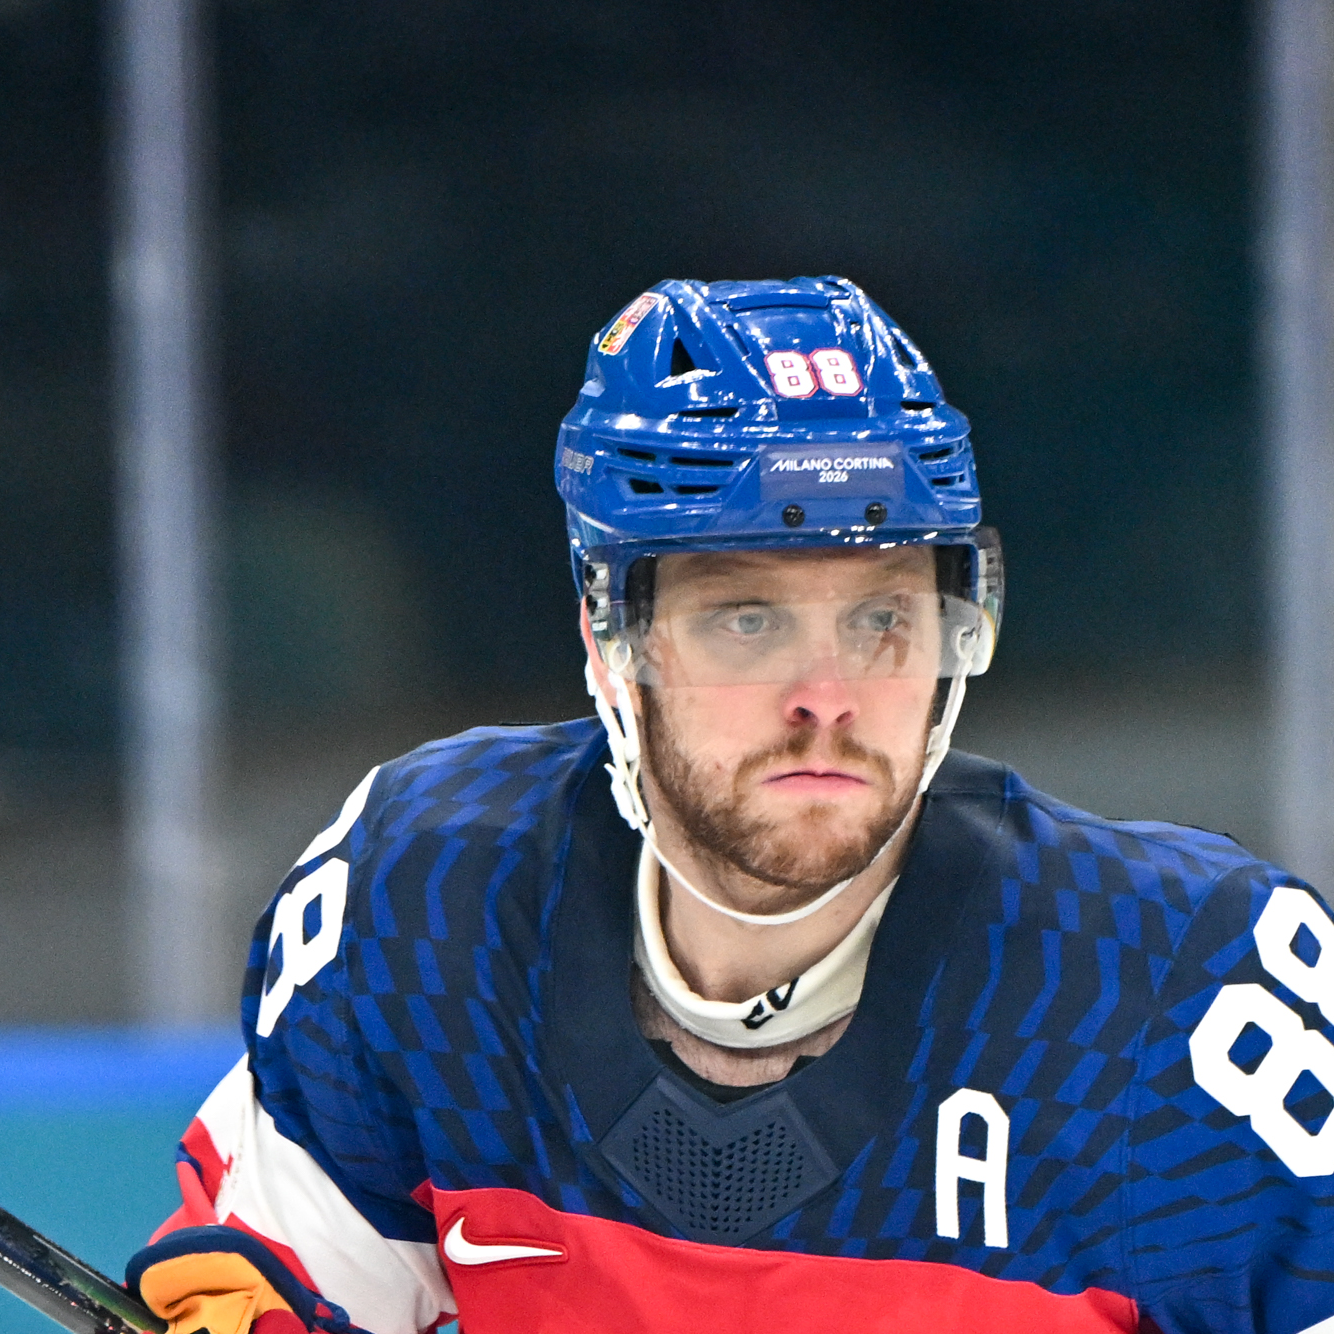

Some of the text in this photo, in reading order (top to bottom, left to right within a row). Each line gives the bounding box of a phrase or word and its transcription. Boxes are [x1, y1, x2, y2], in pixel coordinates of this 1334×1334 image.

[765, 347, 864, 399] 88
[769, 457, 894, 472] MILANO CORTINA
[818, 470, 849, 483] 2026
[934, 1088, 1011, 1249] A
